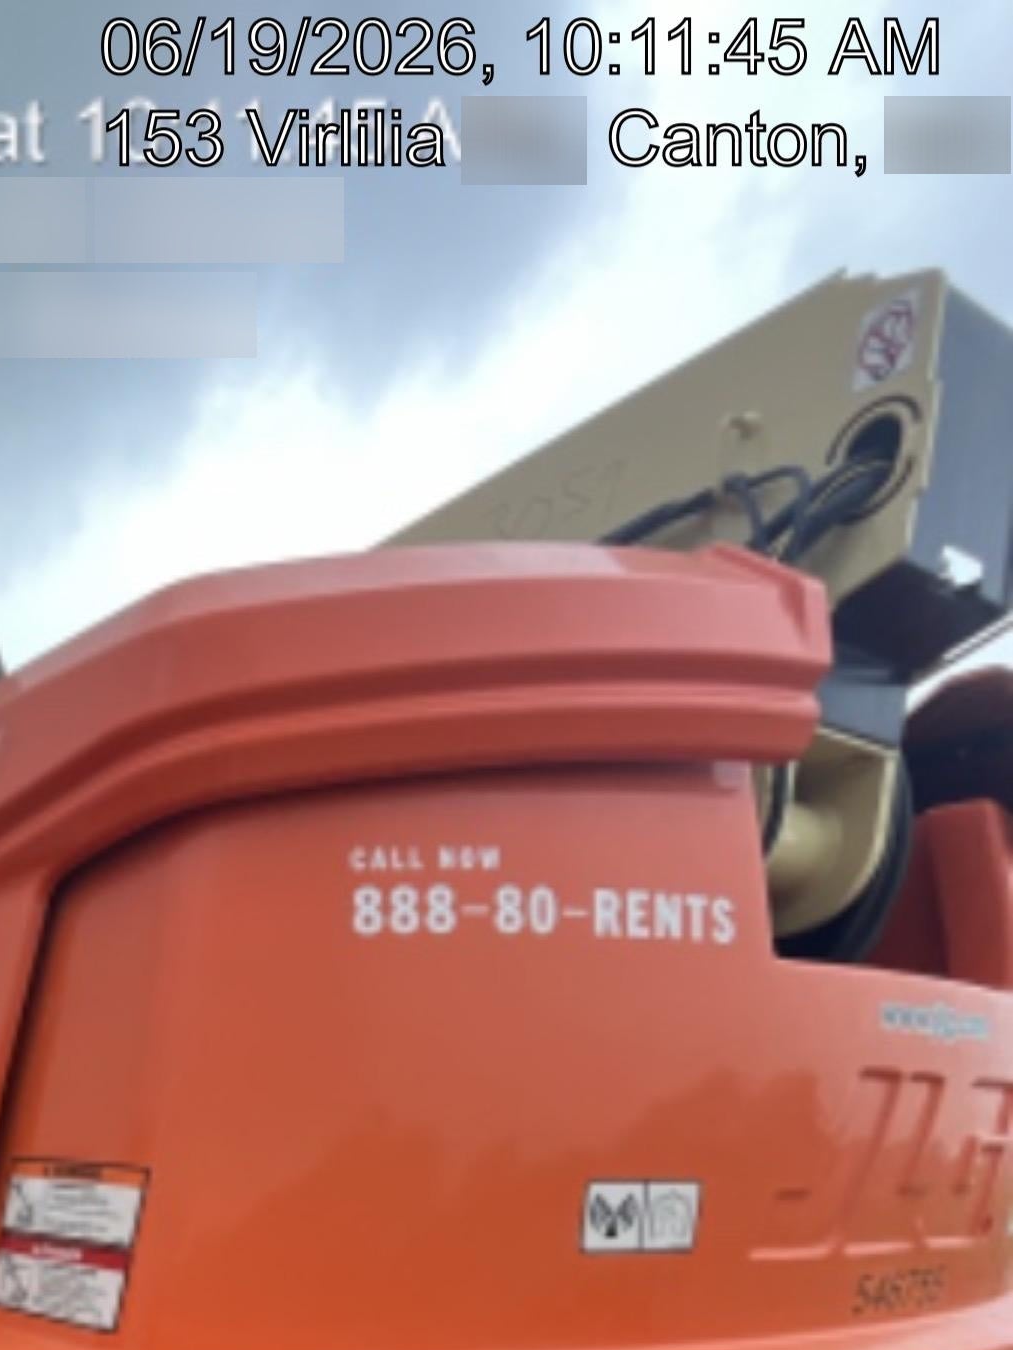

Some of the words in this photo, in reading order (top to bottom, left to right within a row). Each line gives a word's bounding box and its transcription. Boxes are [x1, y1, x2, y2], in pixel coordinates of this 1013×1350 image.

[349, 846, 424, 871] CALL
[438, 846, 501, 871] NOW
[352, 884, 737, 944] 888-80-RENTS
